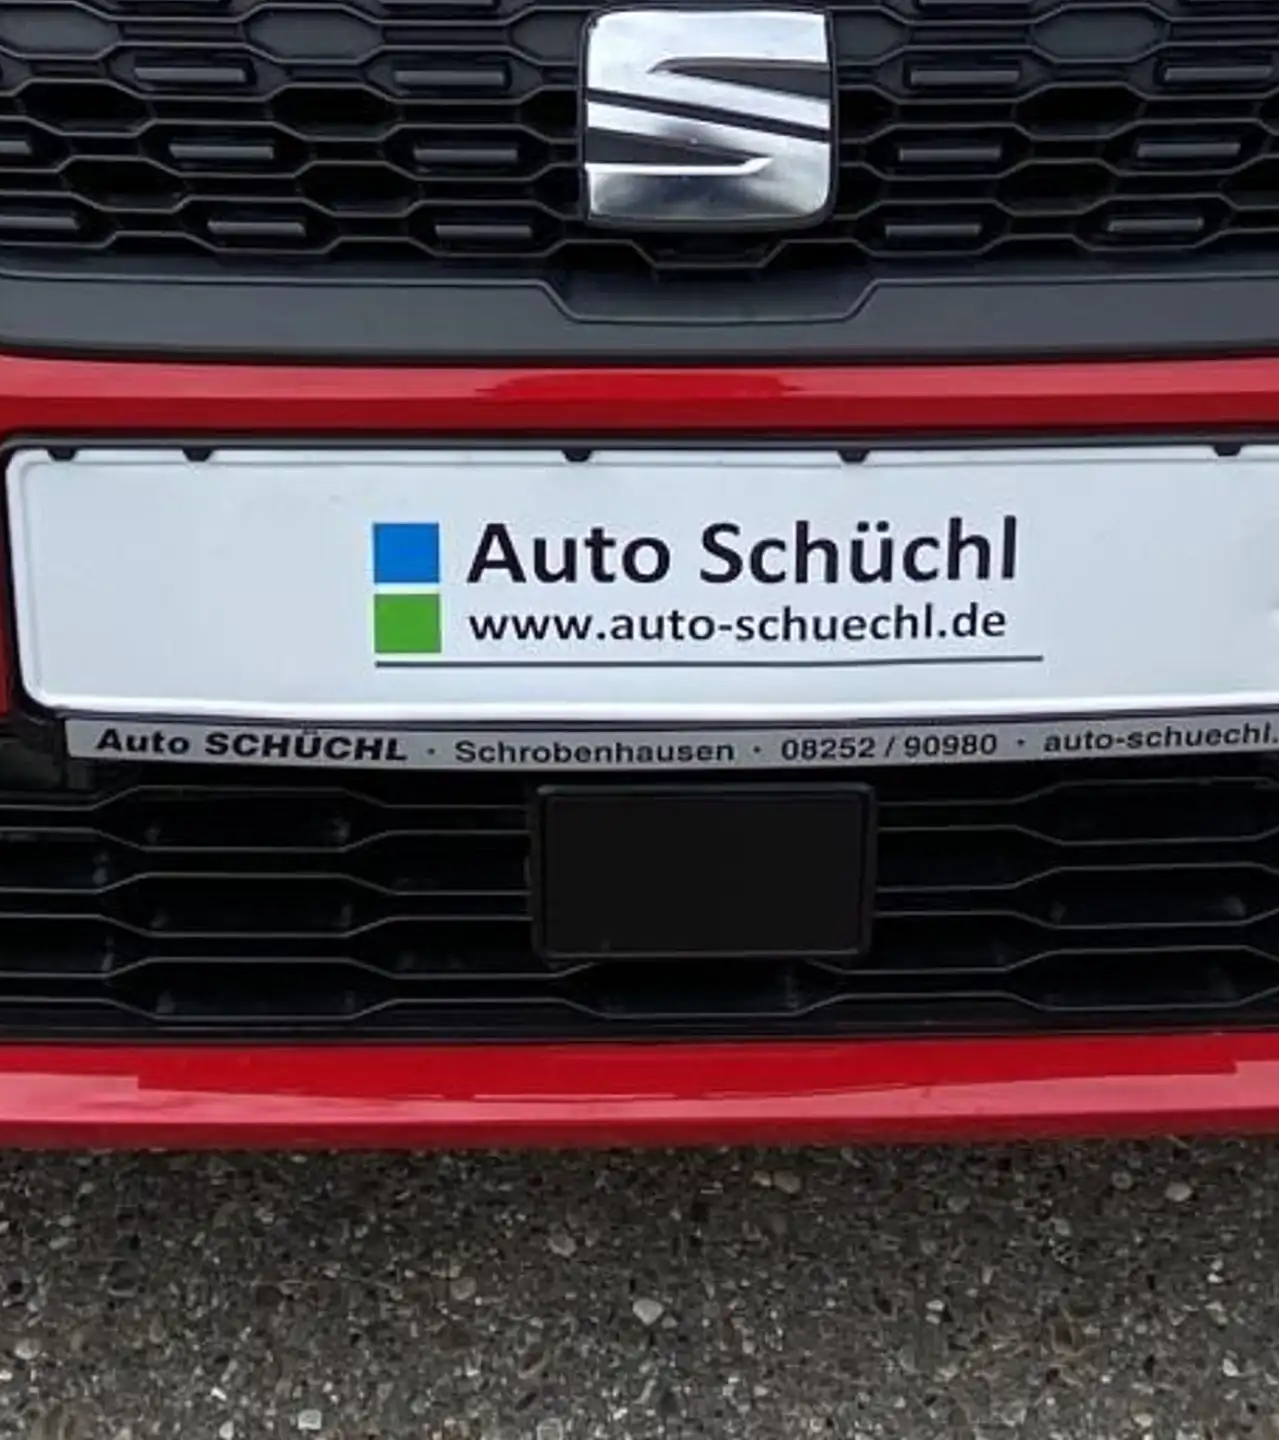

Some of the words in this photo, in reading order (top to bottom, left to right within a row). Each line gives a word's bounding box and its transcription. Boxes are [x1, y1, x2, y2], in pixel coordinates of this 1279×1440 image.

[467, 522, 671, 584] Auto
[700, 515, 1017, 584] Schüchl
[469, 601, 1006, 642] www.auto-schuechl.de
[96, 727, 190, 755] Auto
[204, 726, 408, 762] SCHÜCHL
[455, 739, 734, 765] Schrobenhausen
